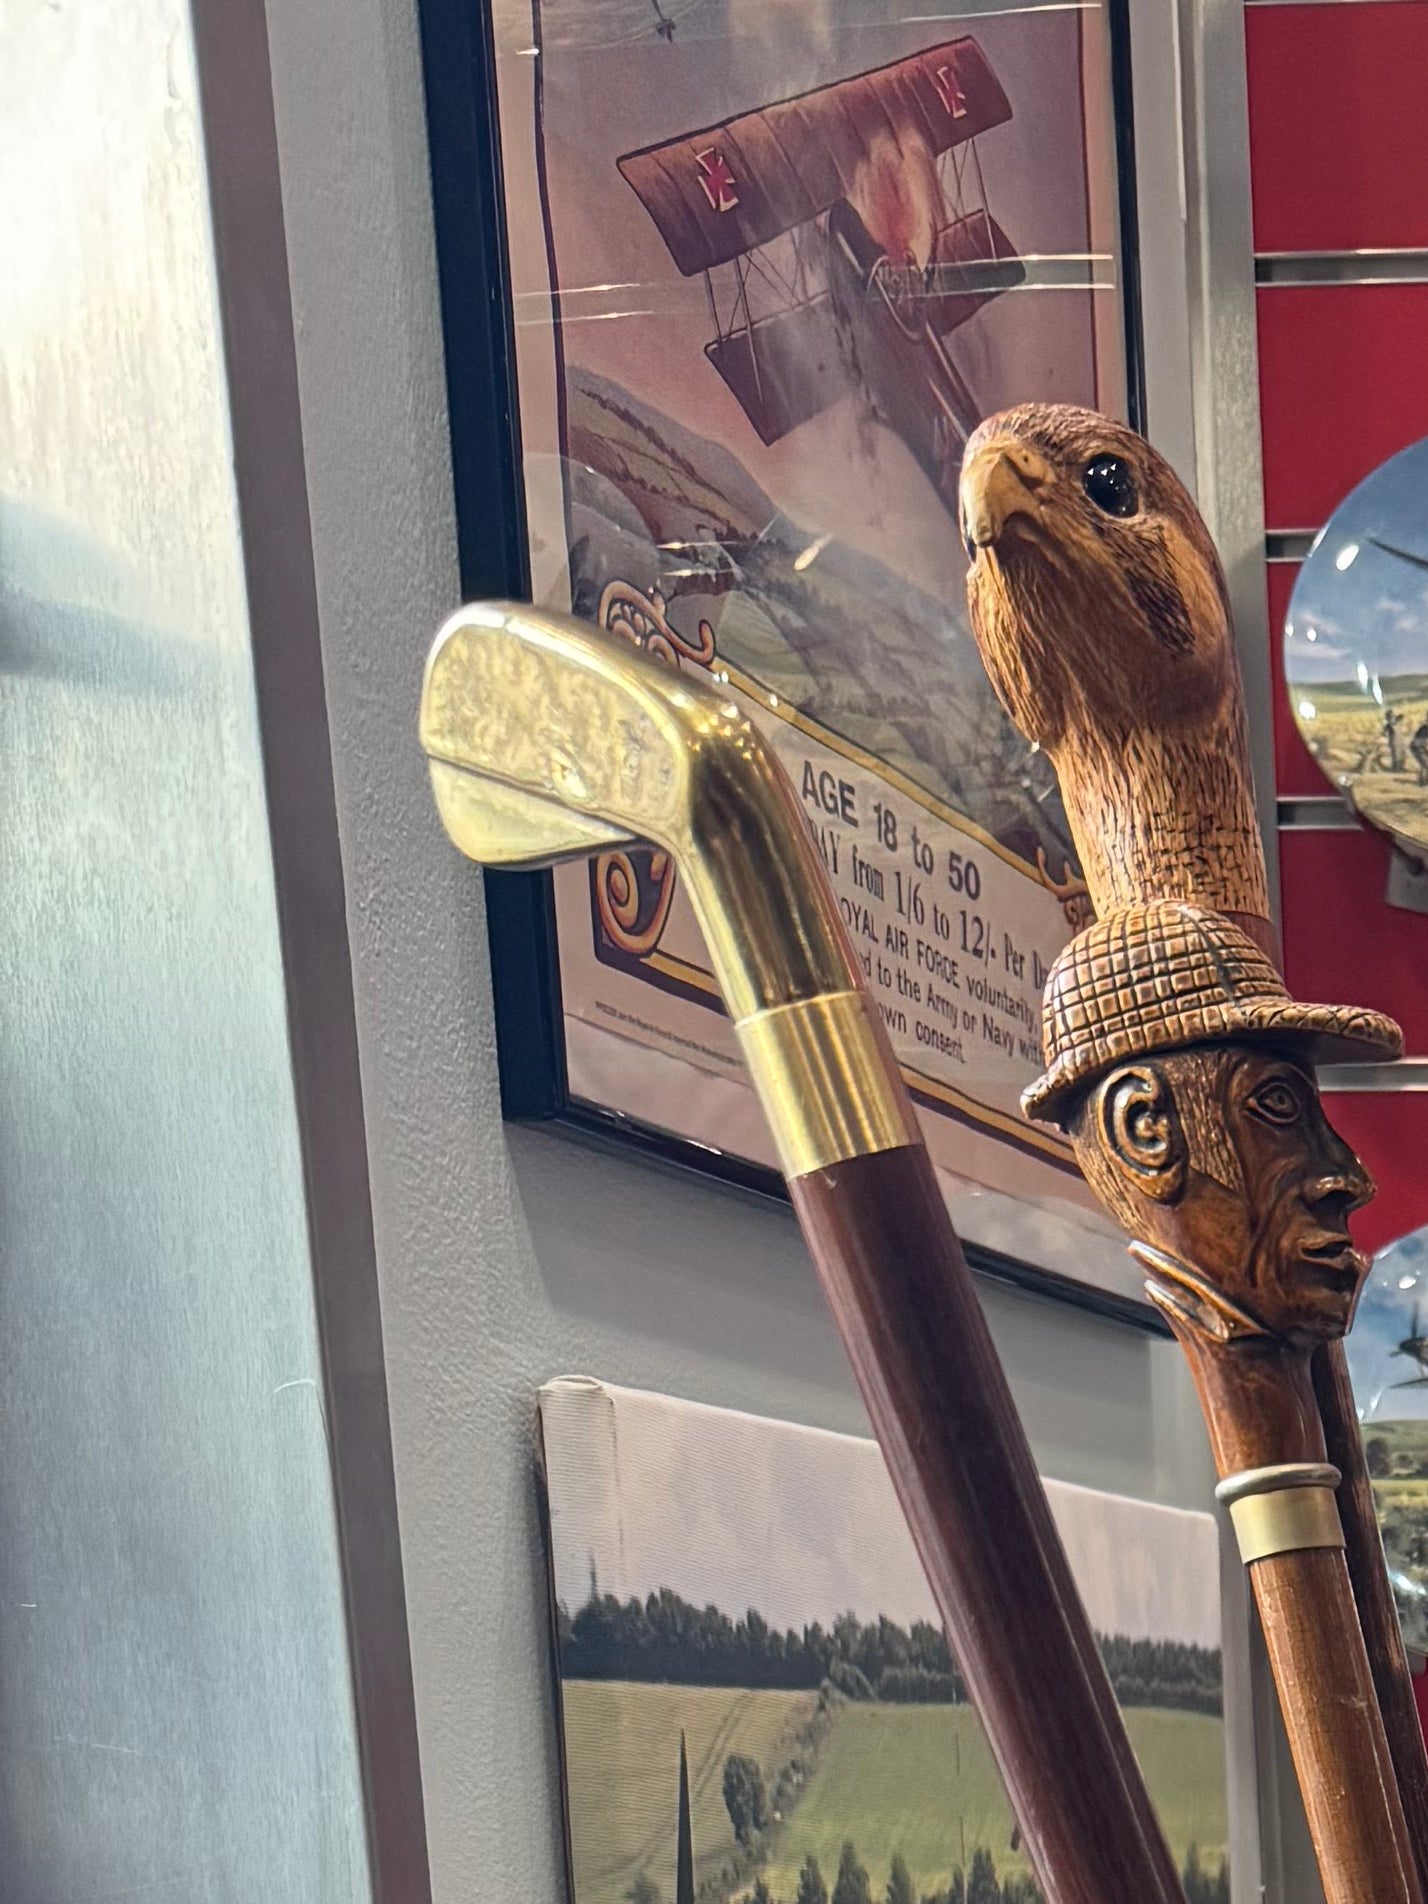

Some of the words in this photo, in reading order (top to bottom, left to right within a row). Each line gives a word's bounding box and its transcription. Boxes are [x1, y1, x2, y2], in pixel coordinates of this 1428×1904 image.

[802, 760, 859, 828] AGE
[873, 803, 898, 853] 18
[911, 825, 934, 875] to
[948, 850, 981, 901] 50
[852, 844, 884, 902] from
[895, 871, 925, 926] 1/6
[933, 903, 950, 940] to
[1004, 932, 1025, 981] Per
[885, 924, 909, 960] AIR
[916, 938, 961, 989] FORCE
[877, 956, 892, 988] to
[896, 967, 921, 1003] the
[926, 983, 959, 1030] Army
[962, 1010, 977, 1033] or
[983, 1012, 1015, 1058] Navy
[915, 1020, 966, 1064] consent
